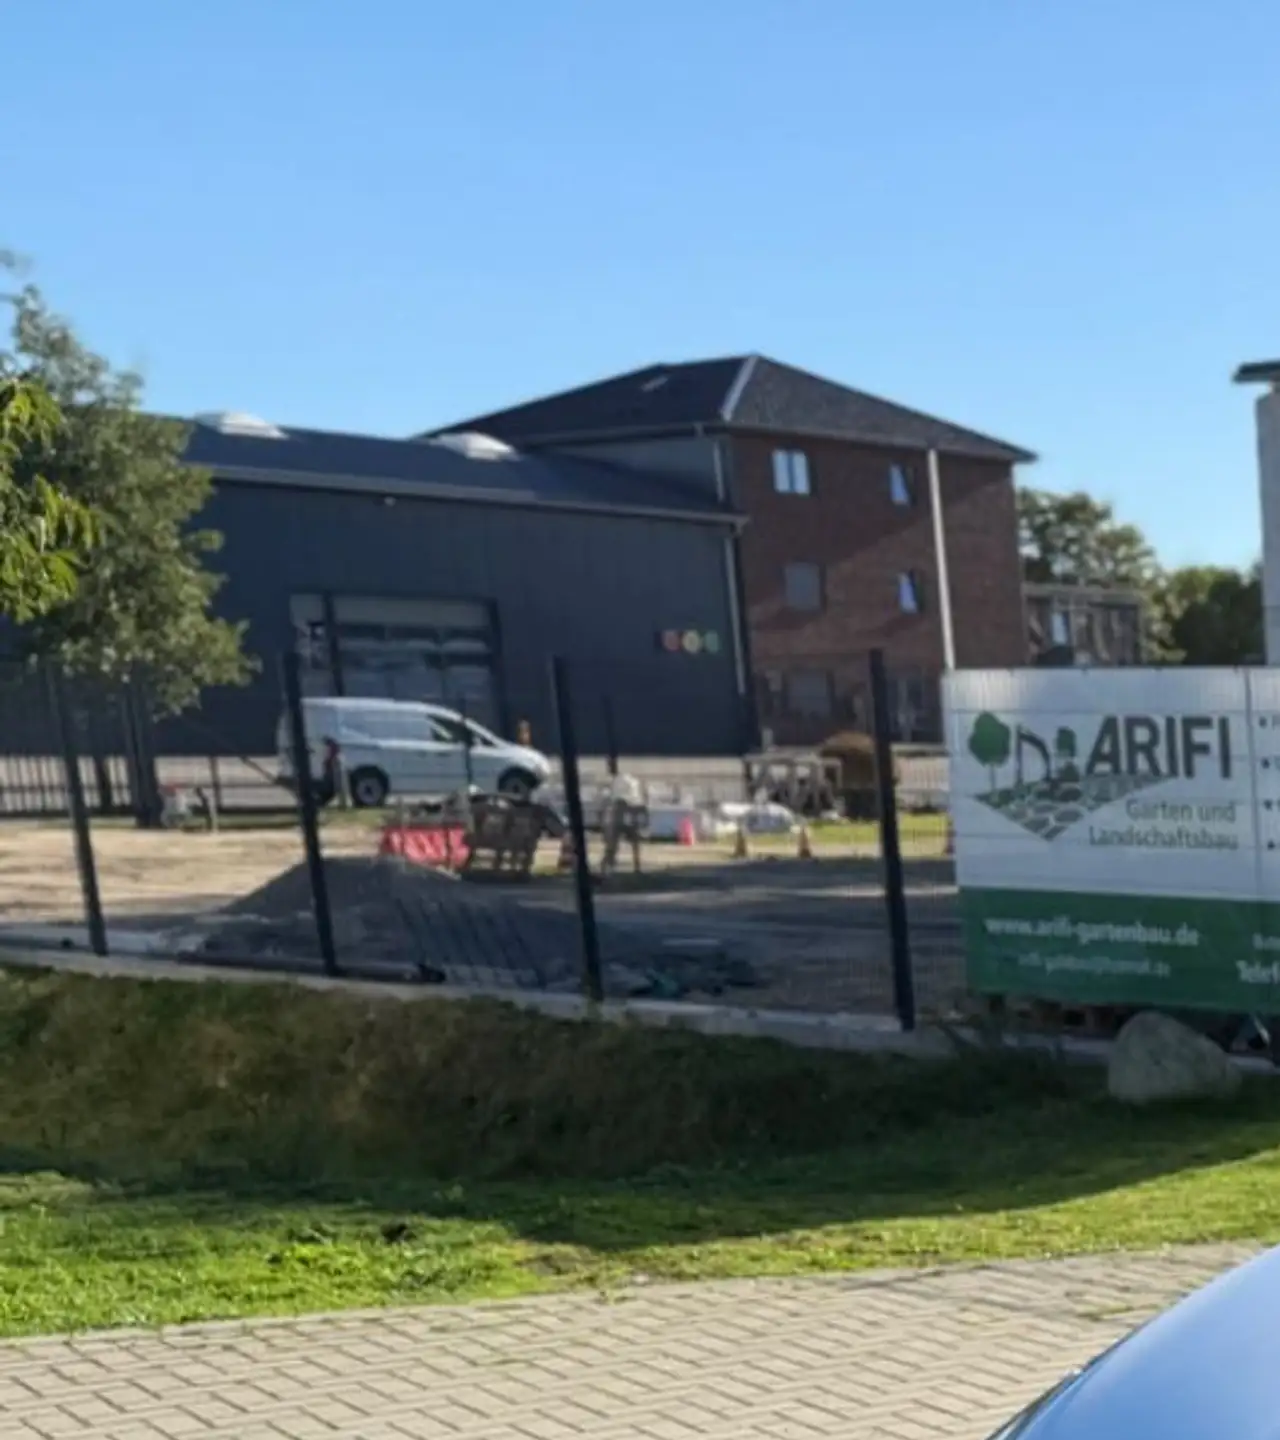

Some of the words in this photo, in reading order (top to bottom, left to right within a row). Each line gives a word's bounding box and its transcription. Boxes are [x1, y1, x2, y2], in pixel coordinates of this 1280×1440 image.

[1085, 714, 1233, 780] ARIFI
[1125, 799, 1194, 822] Garten
[1197, 801, 1237, 824] und
[1088, 824, 1239, 851] Landschaftsbau
